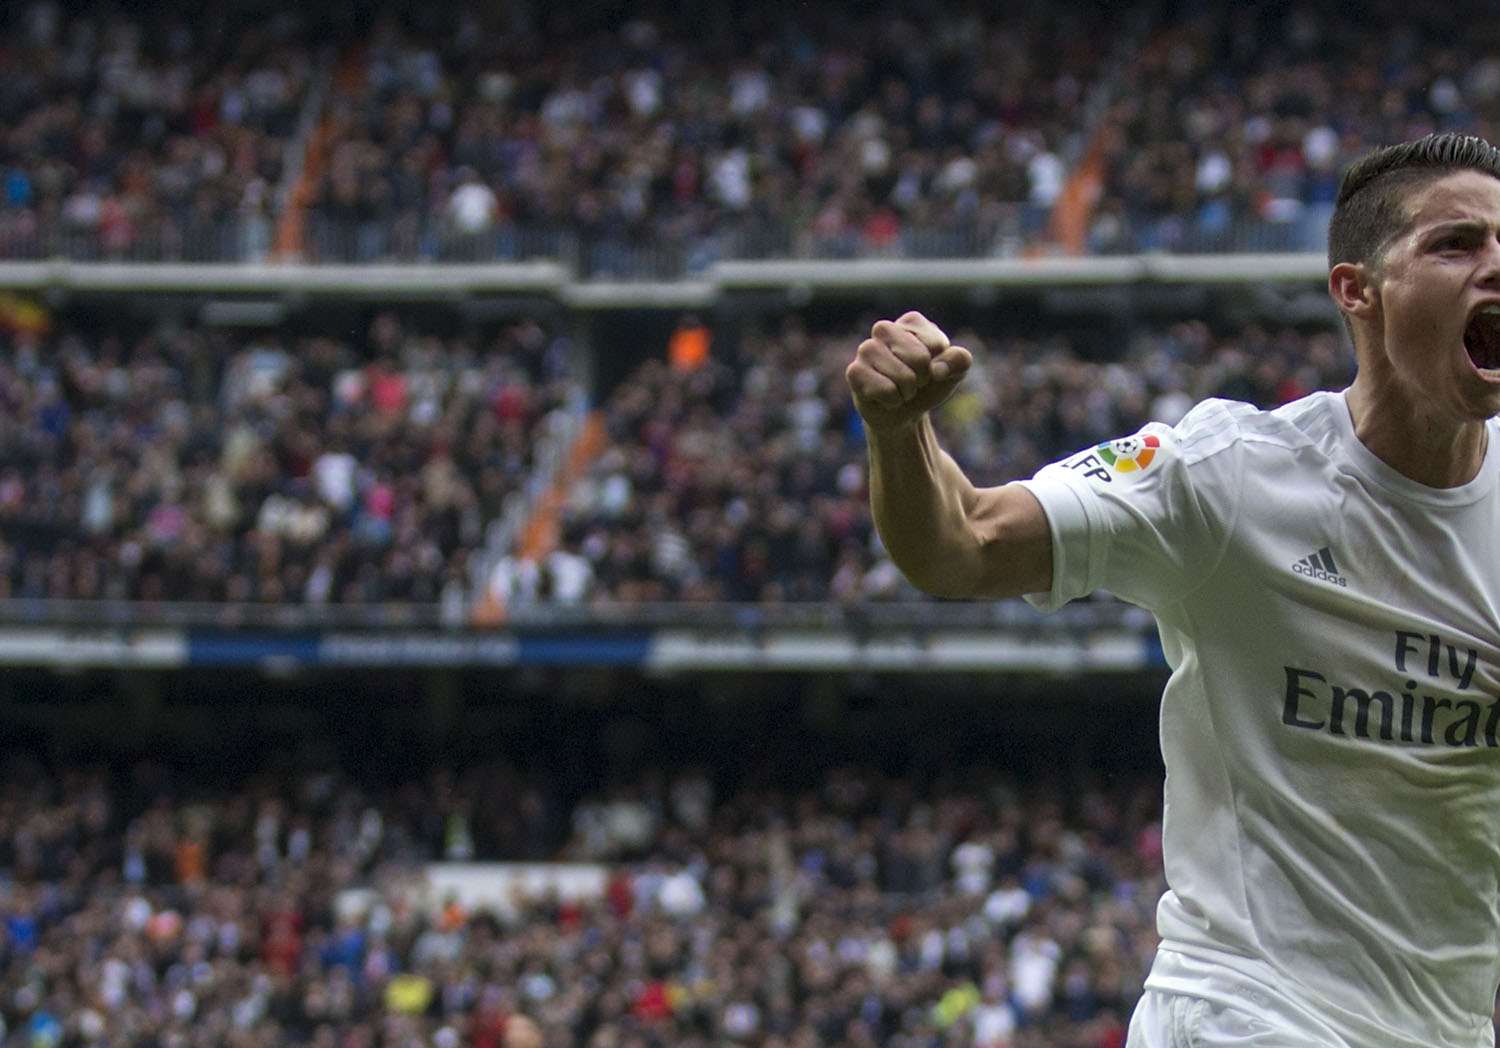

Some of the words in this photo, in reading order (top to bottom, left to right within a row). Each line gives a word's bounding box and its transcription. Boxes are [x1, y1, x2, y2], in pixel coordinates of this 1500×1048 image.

[1060, 454, 1112, 483] FP
[1292, 563, 1347, 588] adidas
[1394, 629, 1478, 690] Fly
